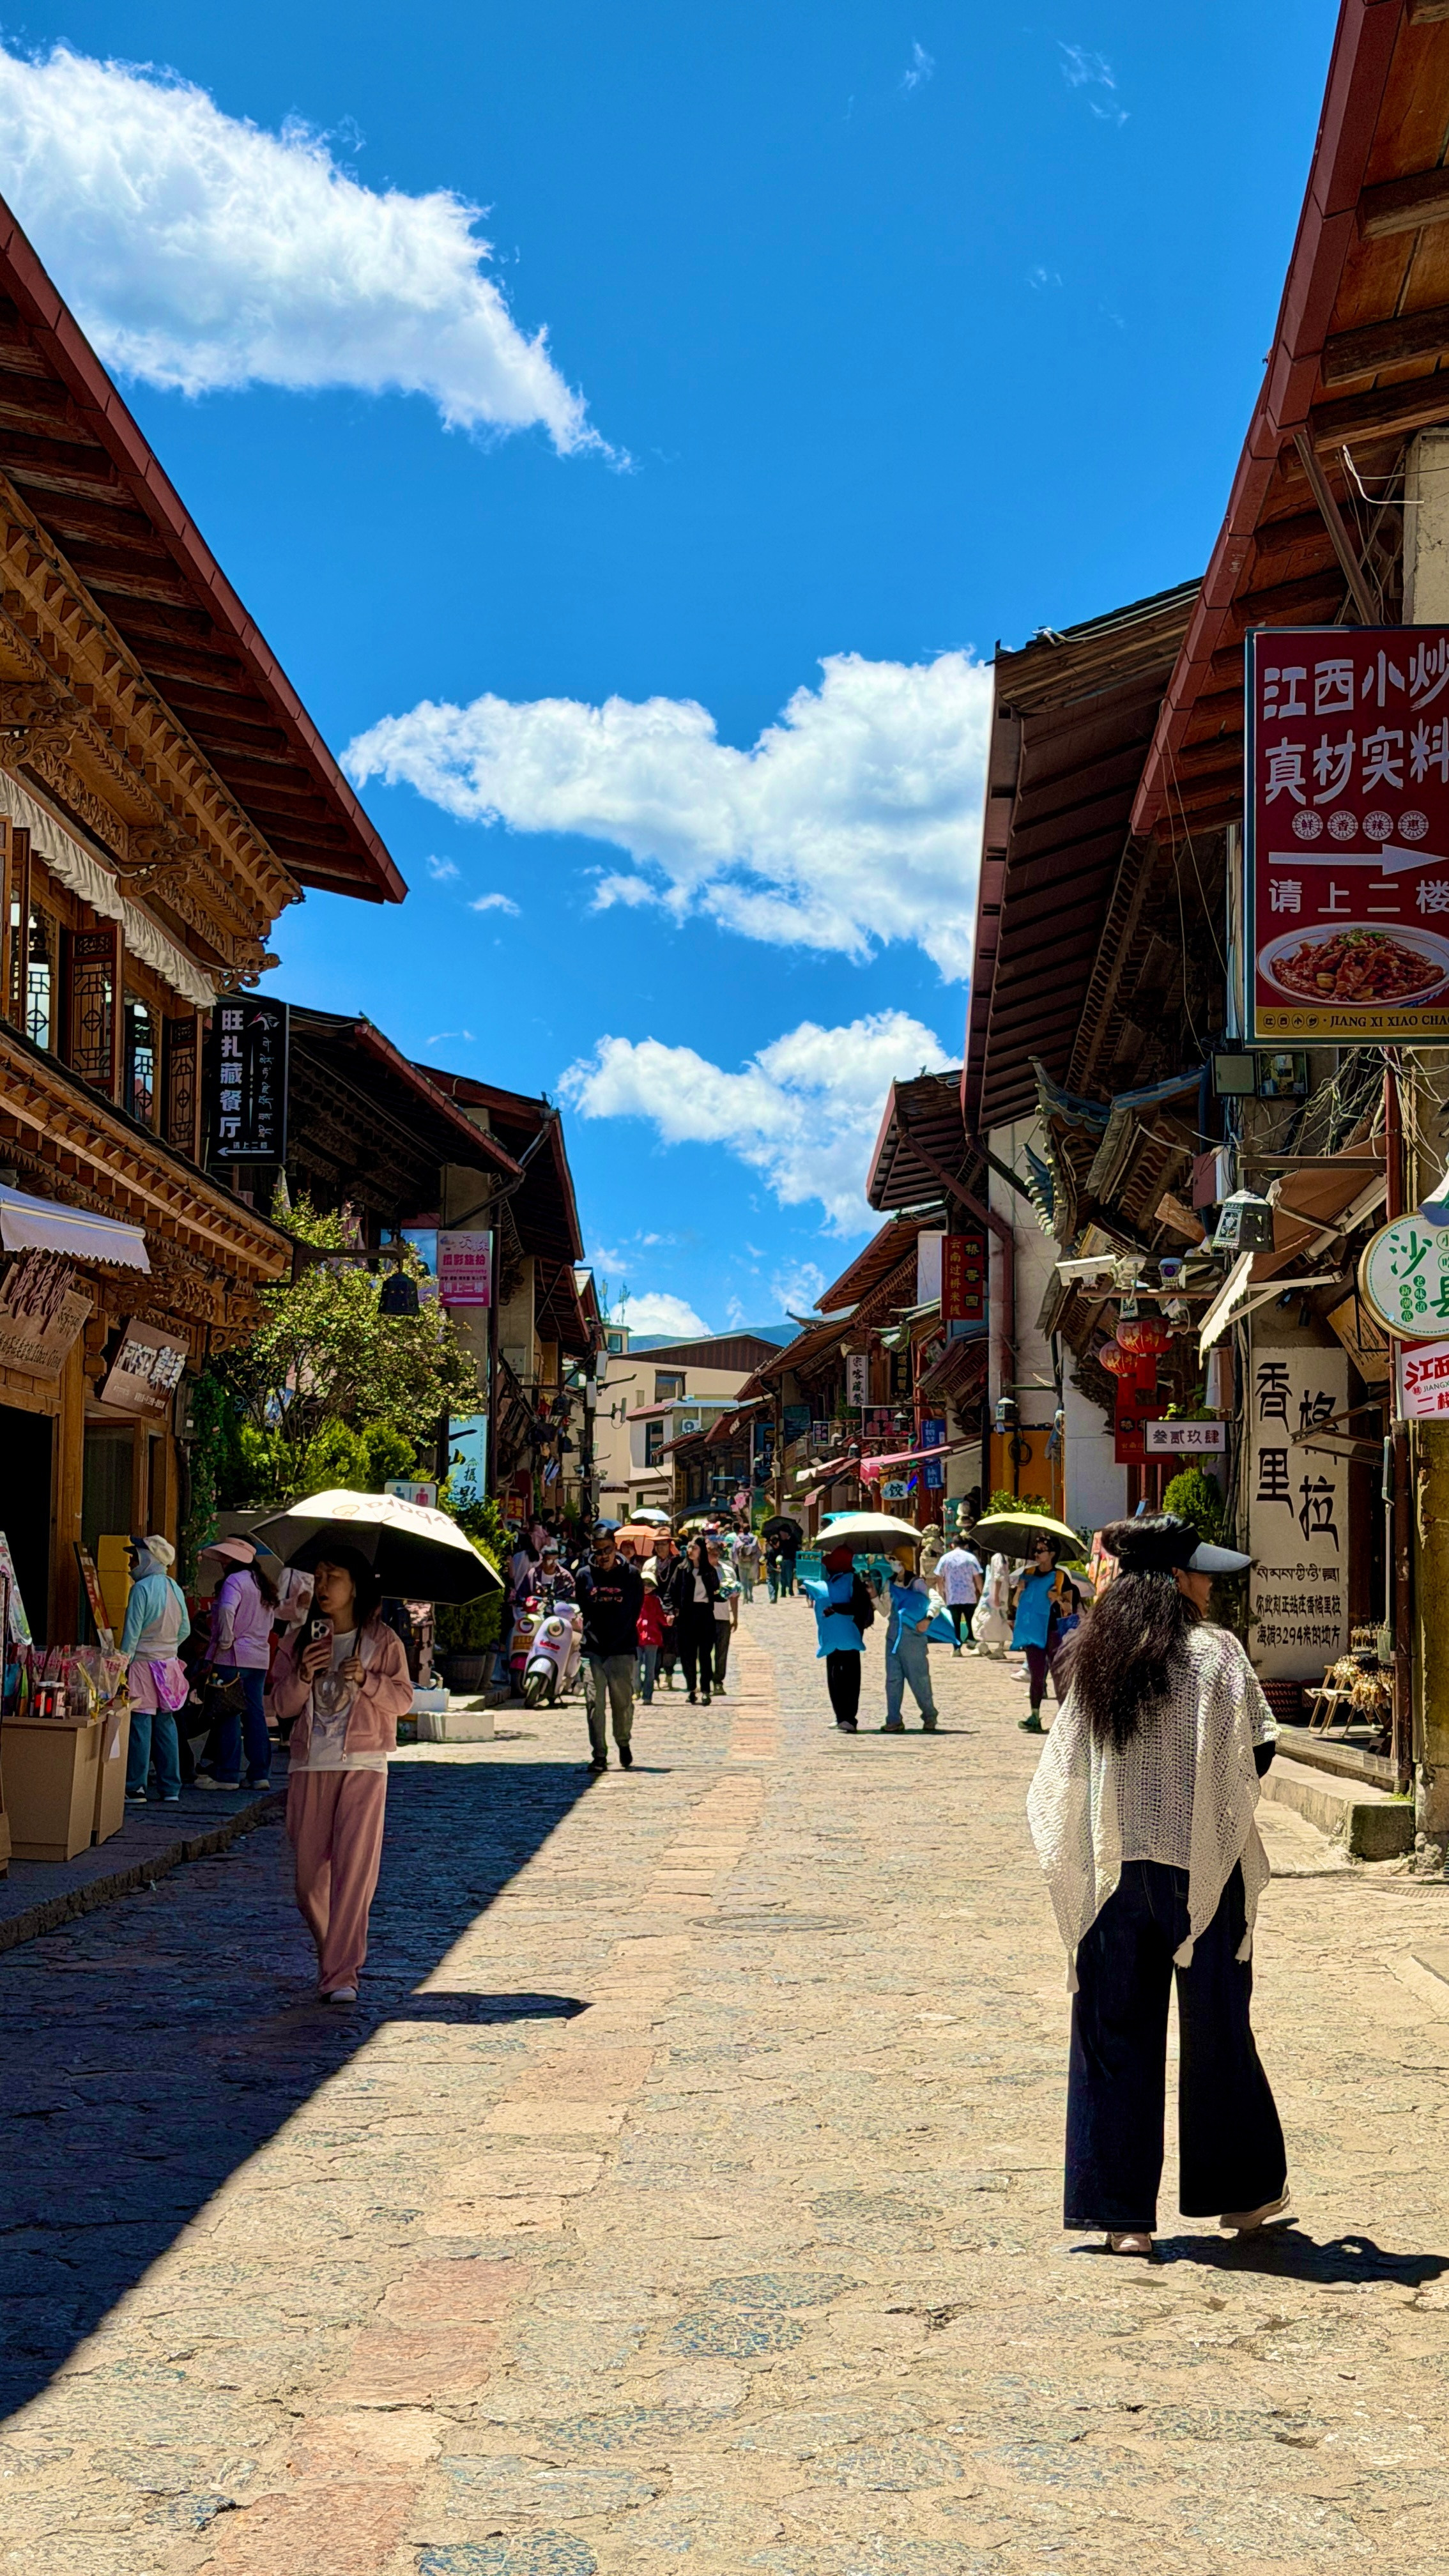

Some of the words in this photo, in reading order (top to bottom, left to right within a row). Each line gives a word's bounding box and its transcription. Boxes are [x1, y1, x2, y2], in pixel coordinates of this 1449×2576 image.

[1263, 637, 1449, 721] 江西小炒
[1266, 717, 1449, 806] 真材实料
[1268, 879, 1449, 914] 请上二楼
[1330, 1015, 1367, 1027] JIANG
[1370, 1016, 1383, 1027] XI
[1387, 1015, 1418, 1027] XIAO
[1422, 1015, 1449, 1025] CHA
[219, 1009, 244, 1138] 旺扎藏餐厅
